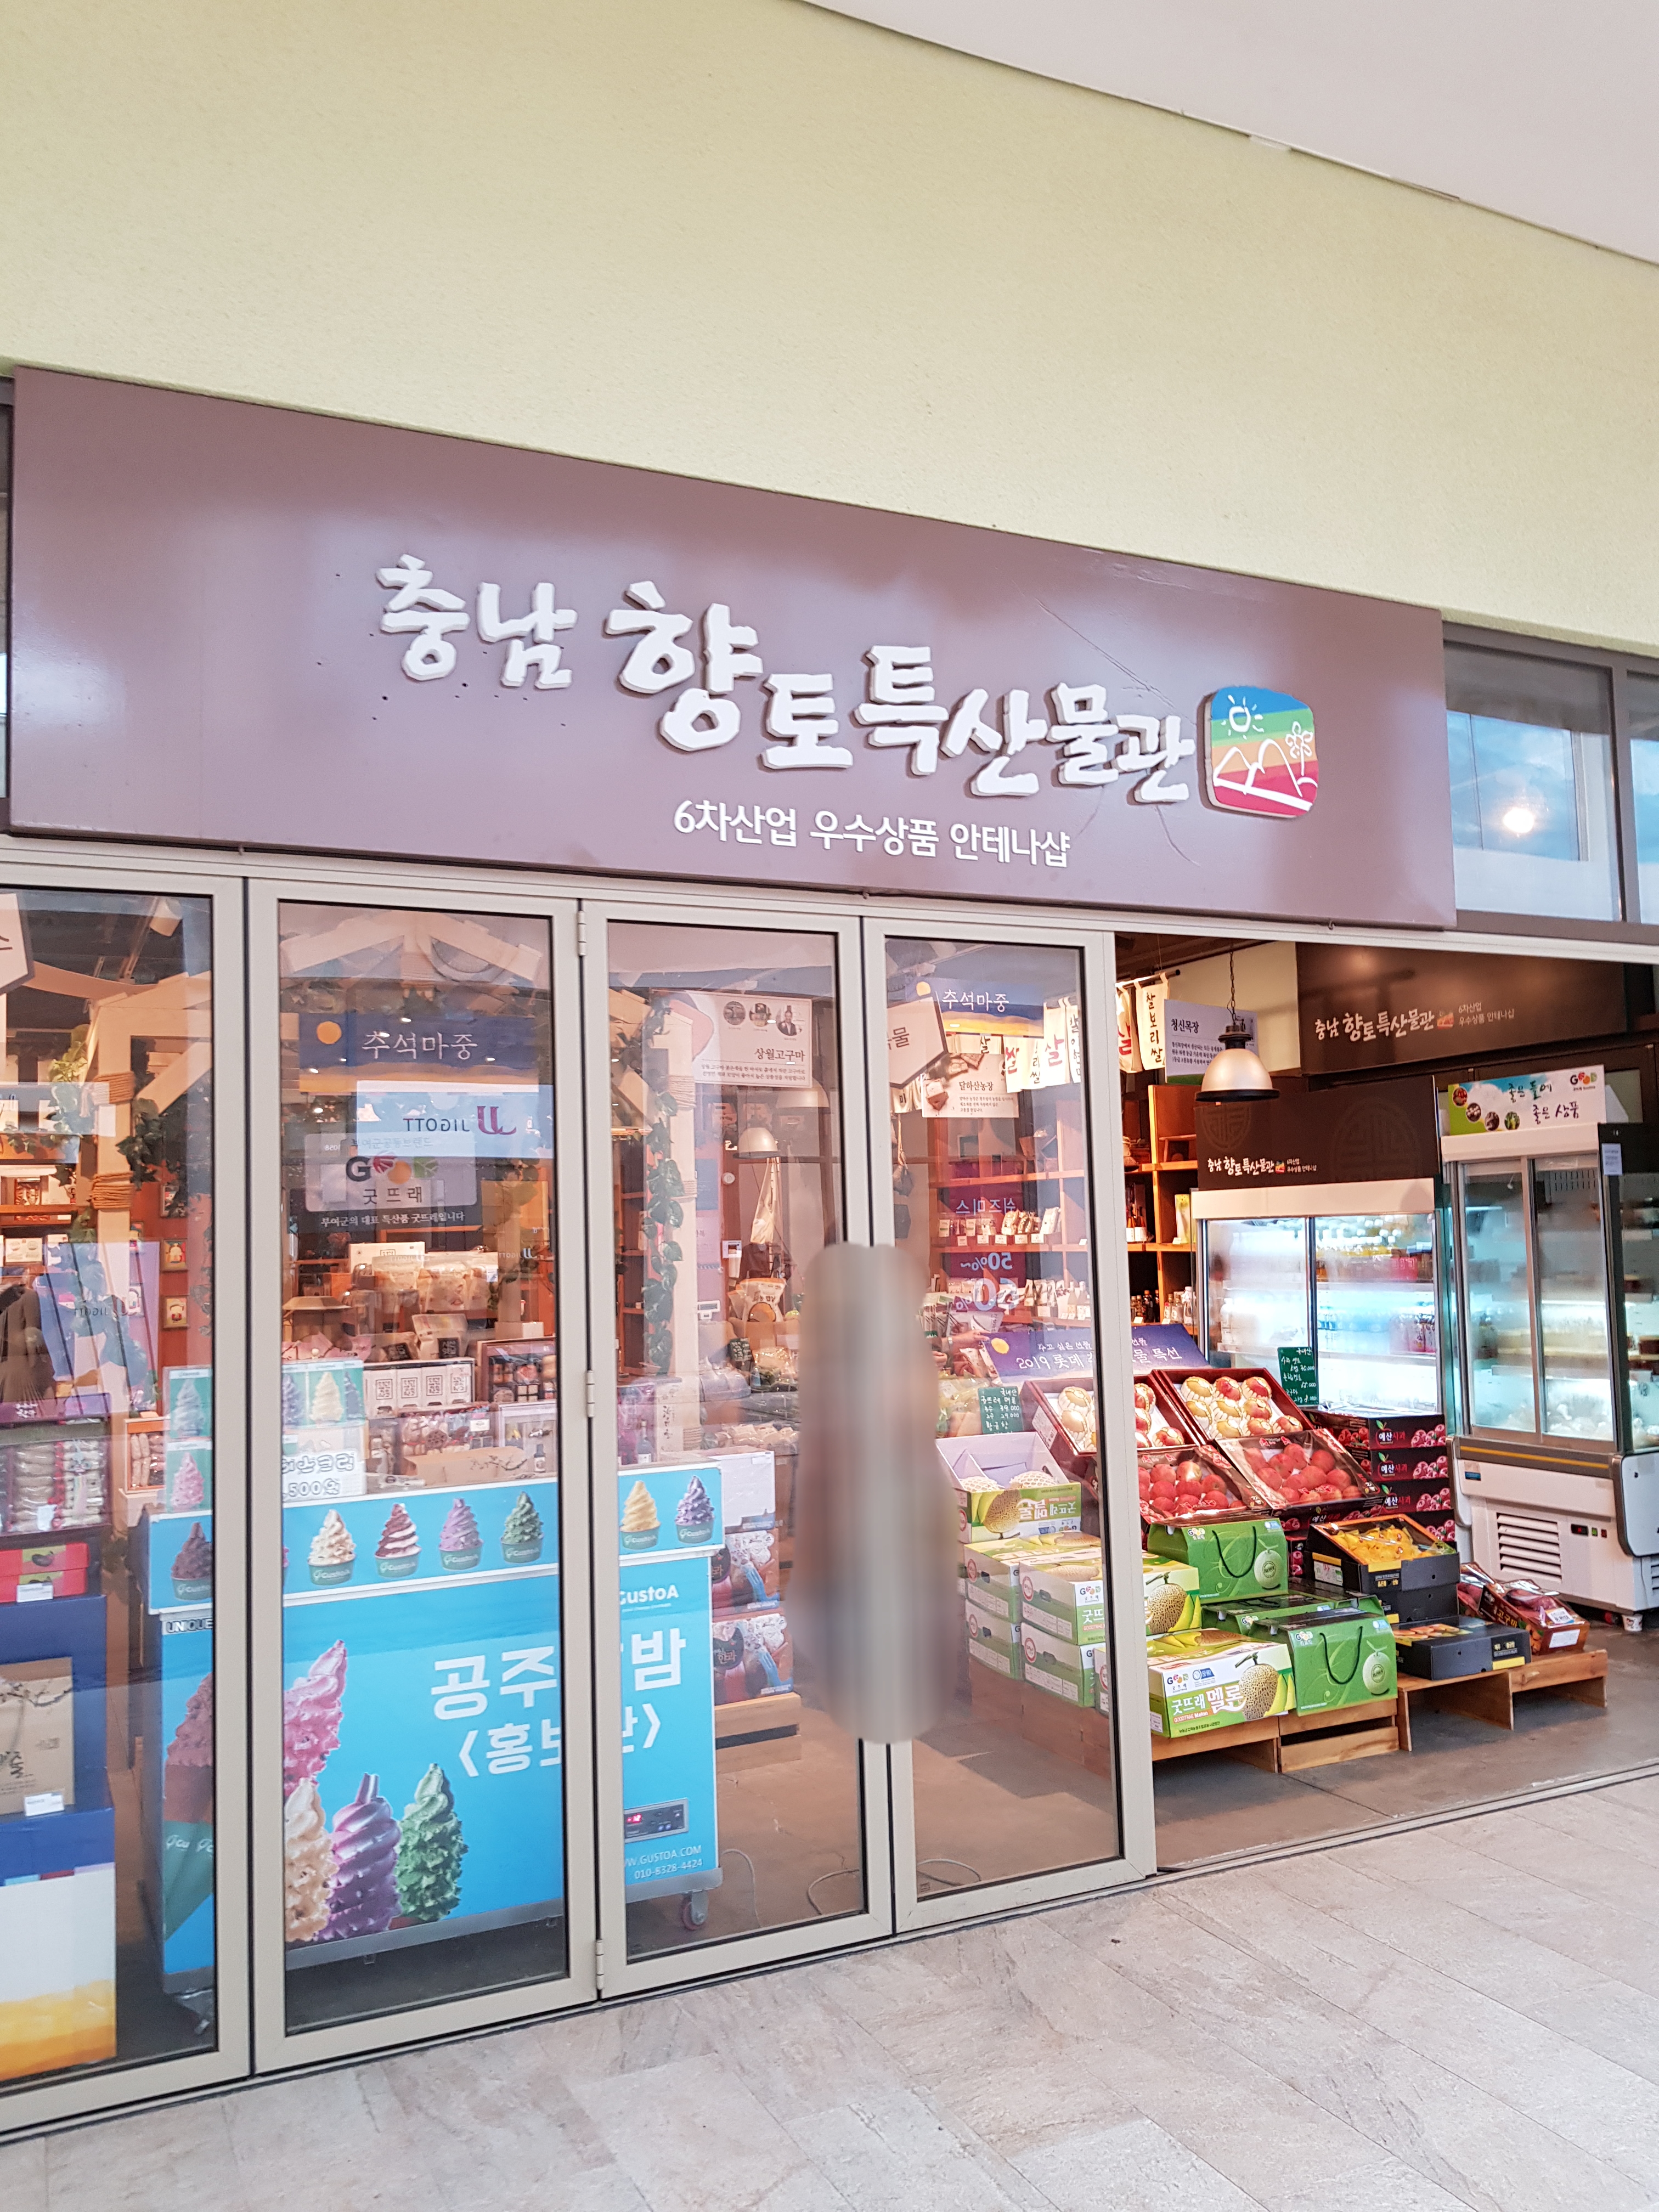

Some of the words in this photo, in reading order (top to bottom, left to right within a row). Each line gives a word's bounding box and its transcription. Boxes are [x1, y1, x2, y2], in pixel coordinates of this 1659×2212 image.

[376, 554, 577, 690] 충남
[674, 800, 797, 847] 6차산업
[810, 809, 939, 858] 우수상품
[950, 822, 1070, 869] 안테나샵
[941, 989, 1009, 1012] 추석마중
[1315, 1017, 1339, 1041] 충남
[362, 1030, 478, 1060] 추석마중
[754, 1048, 805, 1062] 상월고구마
[959, 1081, 994, 1091] 달하산농장
[1555, 1101, 1579, 1119] 상품
[1207, 1158, 1222, 1172] 충남
[320, 1216, 358, 1228] 부여군의
[382, 1214, 410, 1225] 특산품
[1016, 1356, 1051, 1369] 2019
[1052, 1353, 1085, 1369] 롯데
[1497, 1610, 1517, 1628] 고구마
[1171, 1694, 1205, 1716] 굿뜨래
[1205, 1684, 1246, 1714] 멜론
